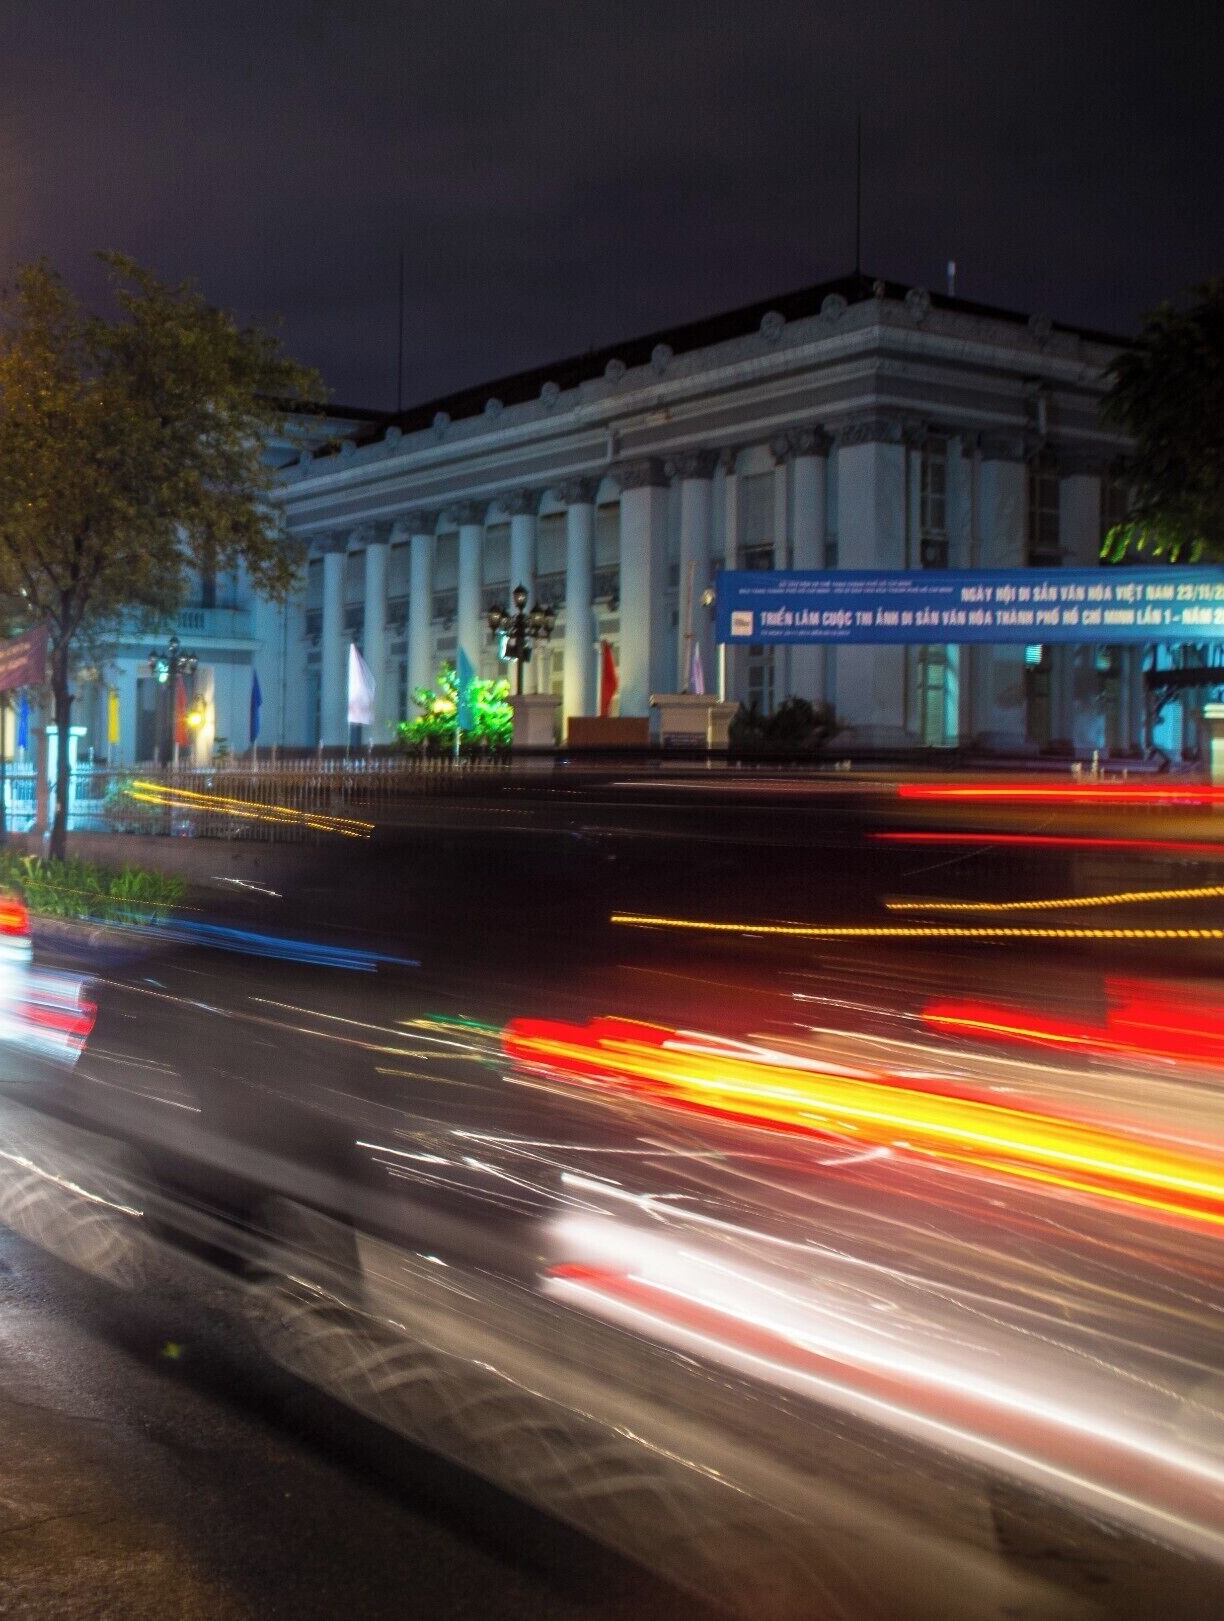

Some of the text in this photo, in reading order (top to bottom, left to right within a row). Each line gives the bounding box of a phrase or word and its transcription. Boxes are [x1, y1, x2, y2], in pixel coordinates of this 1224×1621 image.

[1060, 584, 1085, 602] VĂN
[1115, 582, 1143, 604] VIỆT
[1146, 584, 1175, 601] NAM
[942, 608, 967, 626] VĂN
[996, 607, 1034, 625] THÀNH
[1036, 606, 1060, 625] PHỐ
[1082, 606, 1102, 625] CHÍ
[1104, 609, 1135, 625] MINH
